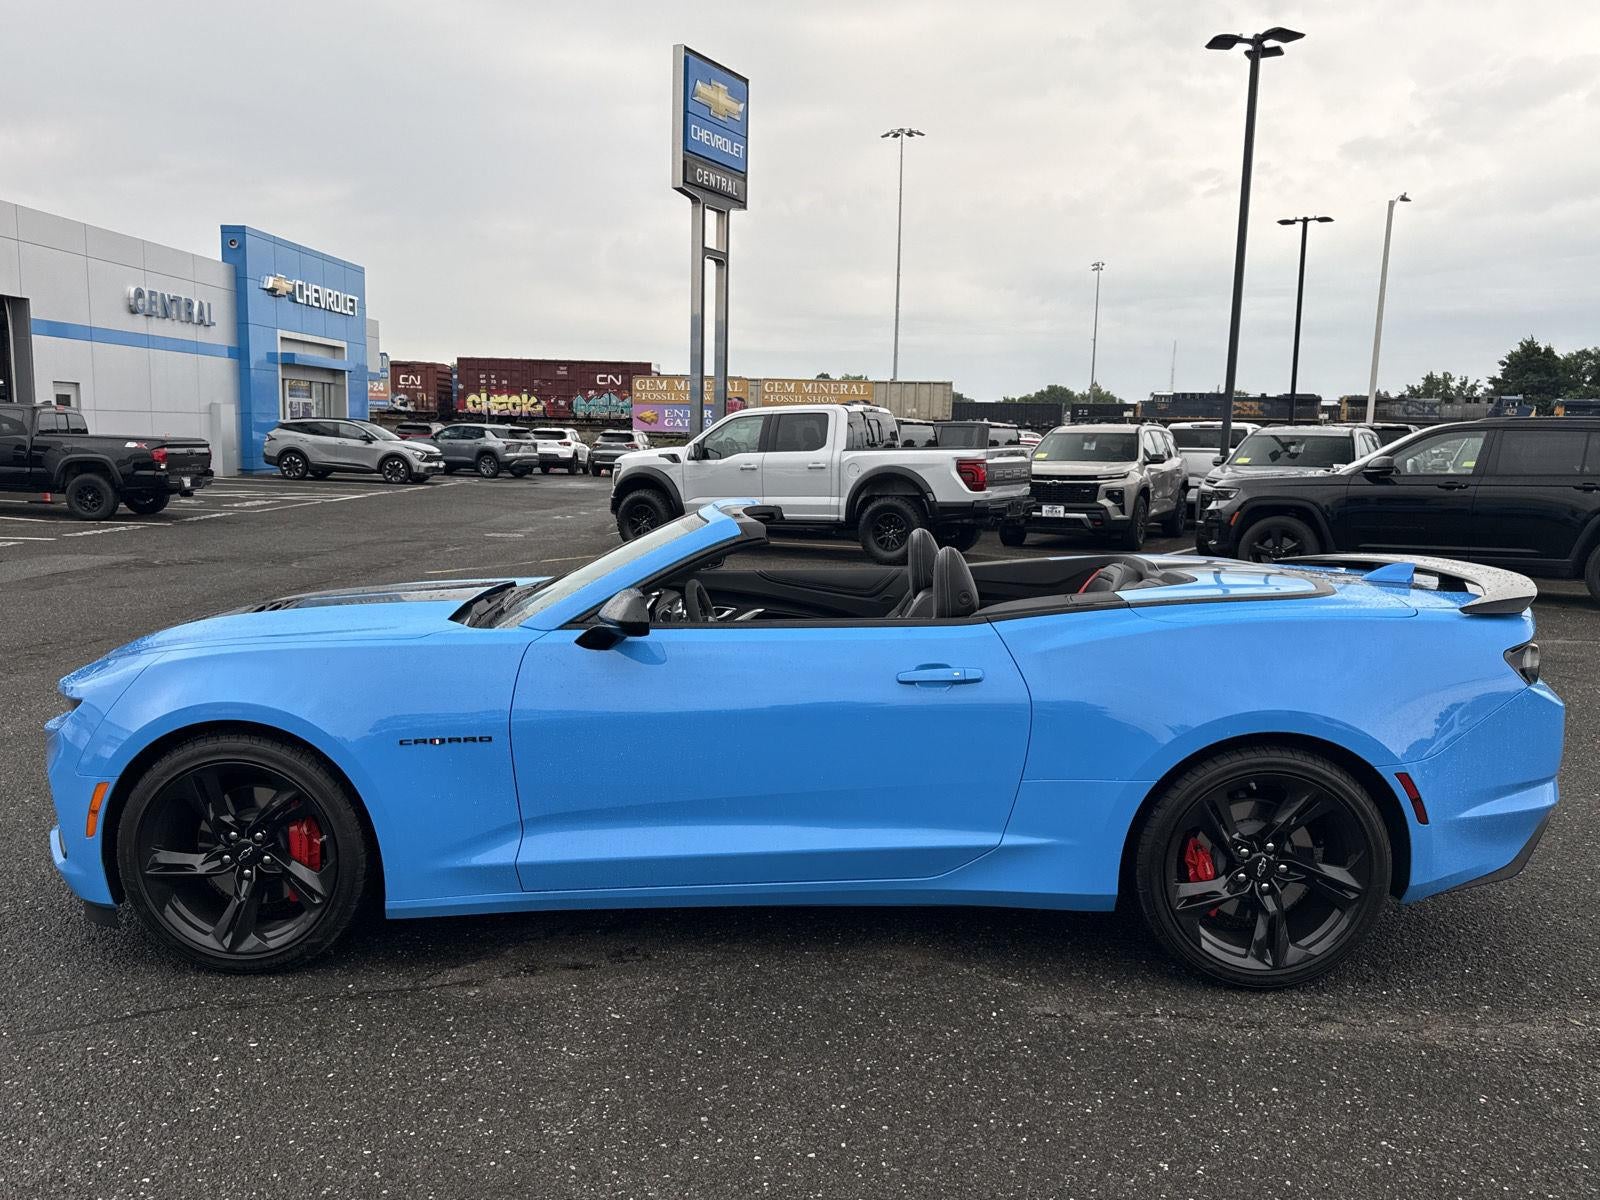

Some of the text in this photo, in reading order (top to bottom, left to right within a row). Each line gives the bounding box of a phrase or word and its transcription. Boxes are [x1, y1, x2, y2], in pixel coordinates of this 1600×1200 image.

[690, 124, 745, 159] CHEVROLET
[696, 167, 738, 196] CENTRAL
[294, 280, 359, 318] CHEVROLET
[129, 286, 216, 327] CENTRAL
[399, 374, 421, 385] CN
[596, 374, 622, 385] CN
[801, 383, 869, 395] MINERAL
[642, 392, 678, 401] FOSSIL
[770, 394, 805, 403] FOSSIL
[806, 395, 838, 404] SHOW
[664, 409, 713, 418] ENTR
[664, 418, 691, 427] GAT
